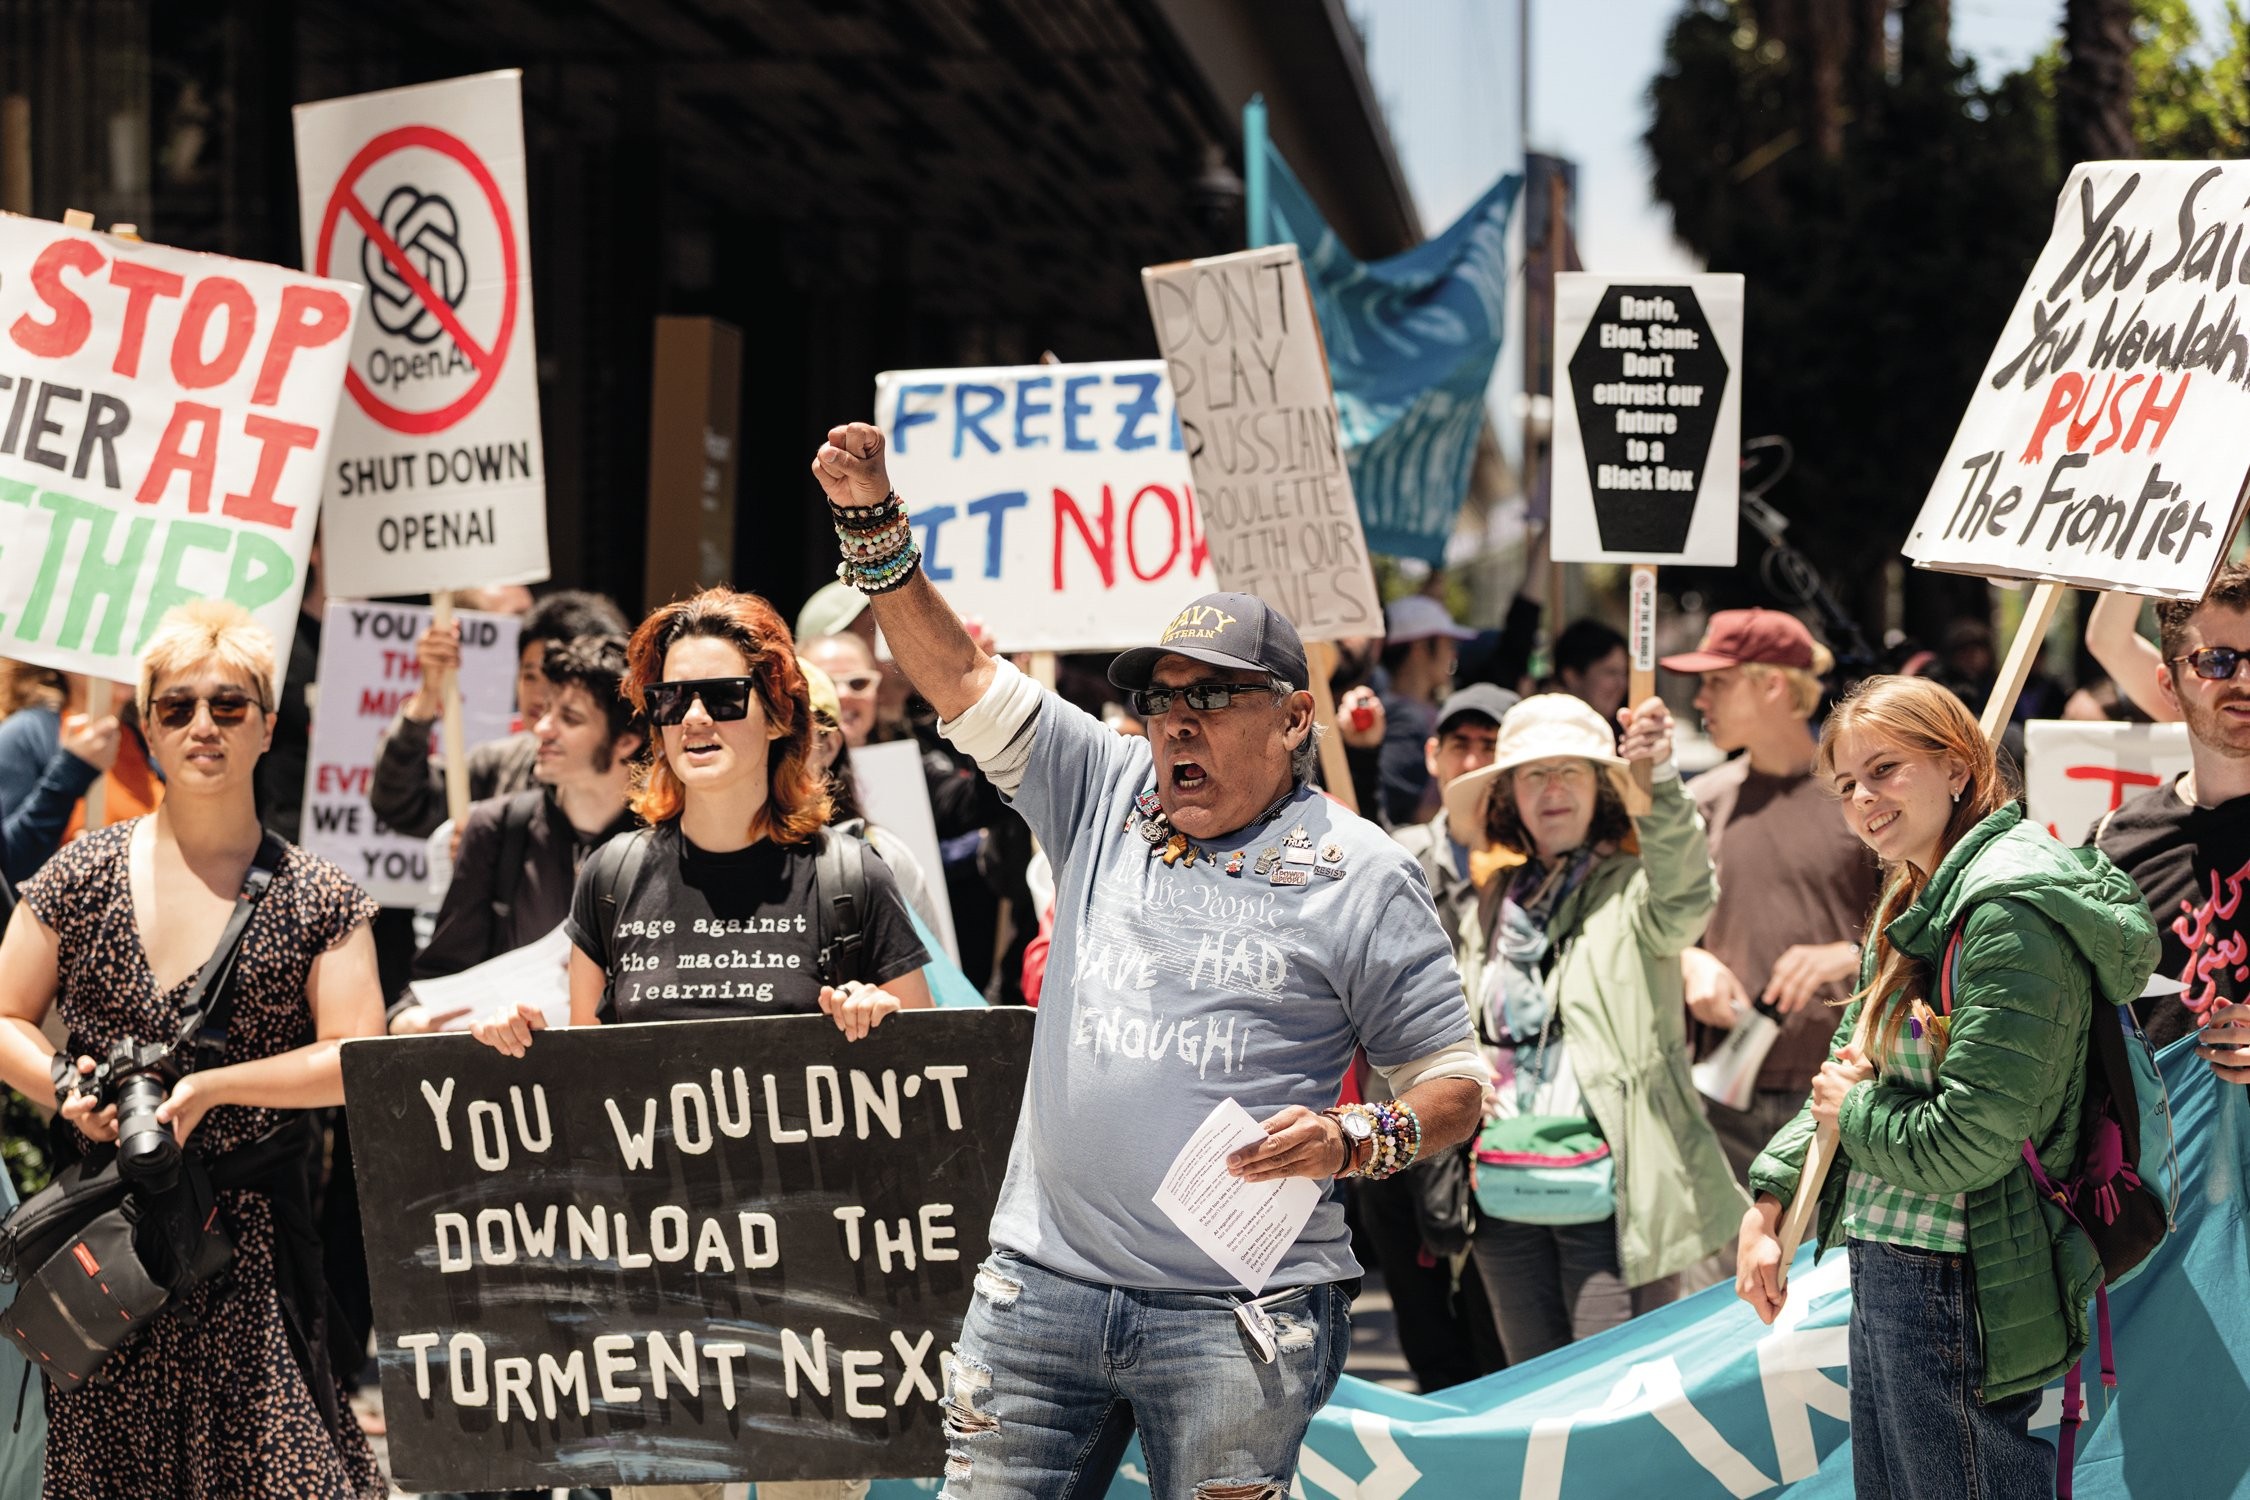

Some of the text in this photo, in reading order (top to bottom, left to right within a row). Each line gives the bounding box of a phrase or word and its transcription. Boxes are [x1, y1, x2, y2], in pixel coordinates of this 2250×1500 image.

[2047, 173, 2152, 302] You
[9, 238, 350, 405] STOP
[1621, 295, 1679, 323] Dario,
[1600, 323, 1647, 351] Elon,
[1992, 294, 2250, 391] You Wouldn
[368, 345, 475, 391] OpenA
[1170, 339, 1284, 412] PLAY
[1623, 352, 1674, 377] Don't
[1593, 381, 1703, 407] entrust our
[1182, 405, 1340, 477] RUSSIAN
[1615, 408, 1677, 434] future
[2019, 371, 2191, 465] PUSH
[135, 401, 319, 529] AI
[338, 441, 530, 496] SHUT DOWN
[1626, 438, 1664, 462] to a
[1598, 464, 1694, 491] Black Box
[1942, 450, 2022, 542] The
[1198, 475, 1347, 532] ROULETTE
[379, 509, 494, 552] OPENAI
[909, 491, 1028, 580] IT
[1216, 520, 1361, 578] WITH OUR
[1240, 565, 1367, 626] IVES
[352, 611, 416, 640] YOU
[1164, 605, 1236, 635] NAVY
[313, 805, 358, 834] WE
[363, 851, 428, 880] YOU
[1282, 837, 1312, 849] TRUMP
[1314, 866, 1346, 880] RESIST
[618, 914, 807, 939] rage against
[1178, 884, 1285, 929] People
[620, 950, 801, 972] the machine
[1190, 931, 1286, 991] HAD
[630, 981, 774, 1003] learning
[1072, 1007, 1250, 1080] ENOUGH!
[420, 1064, 968, 1171] YOU WOULDN'T
[435, 1202, 960, 1273] DOWNLOAD THE
[396, 1327, 955, 1423] TORMENT NEX
